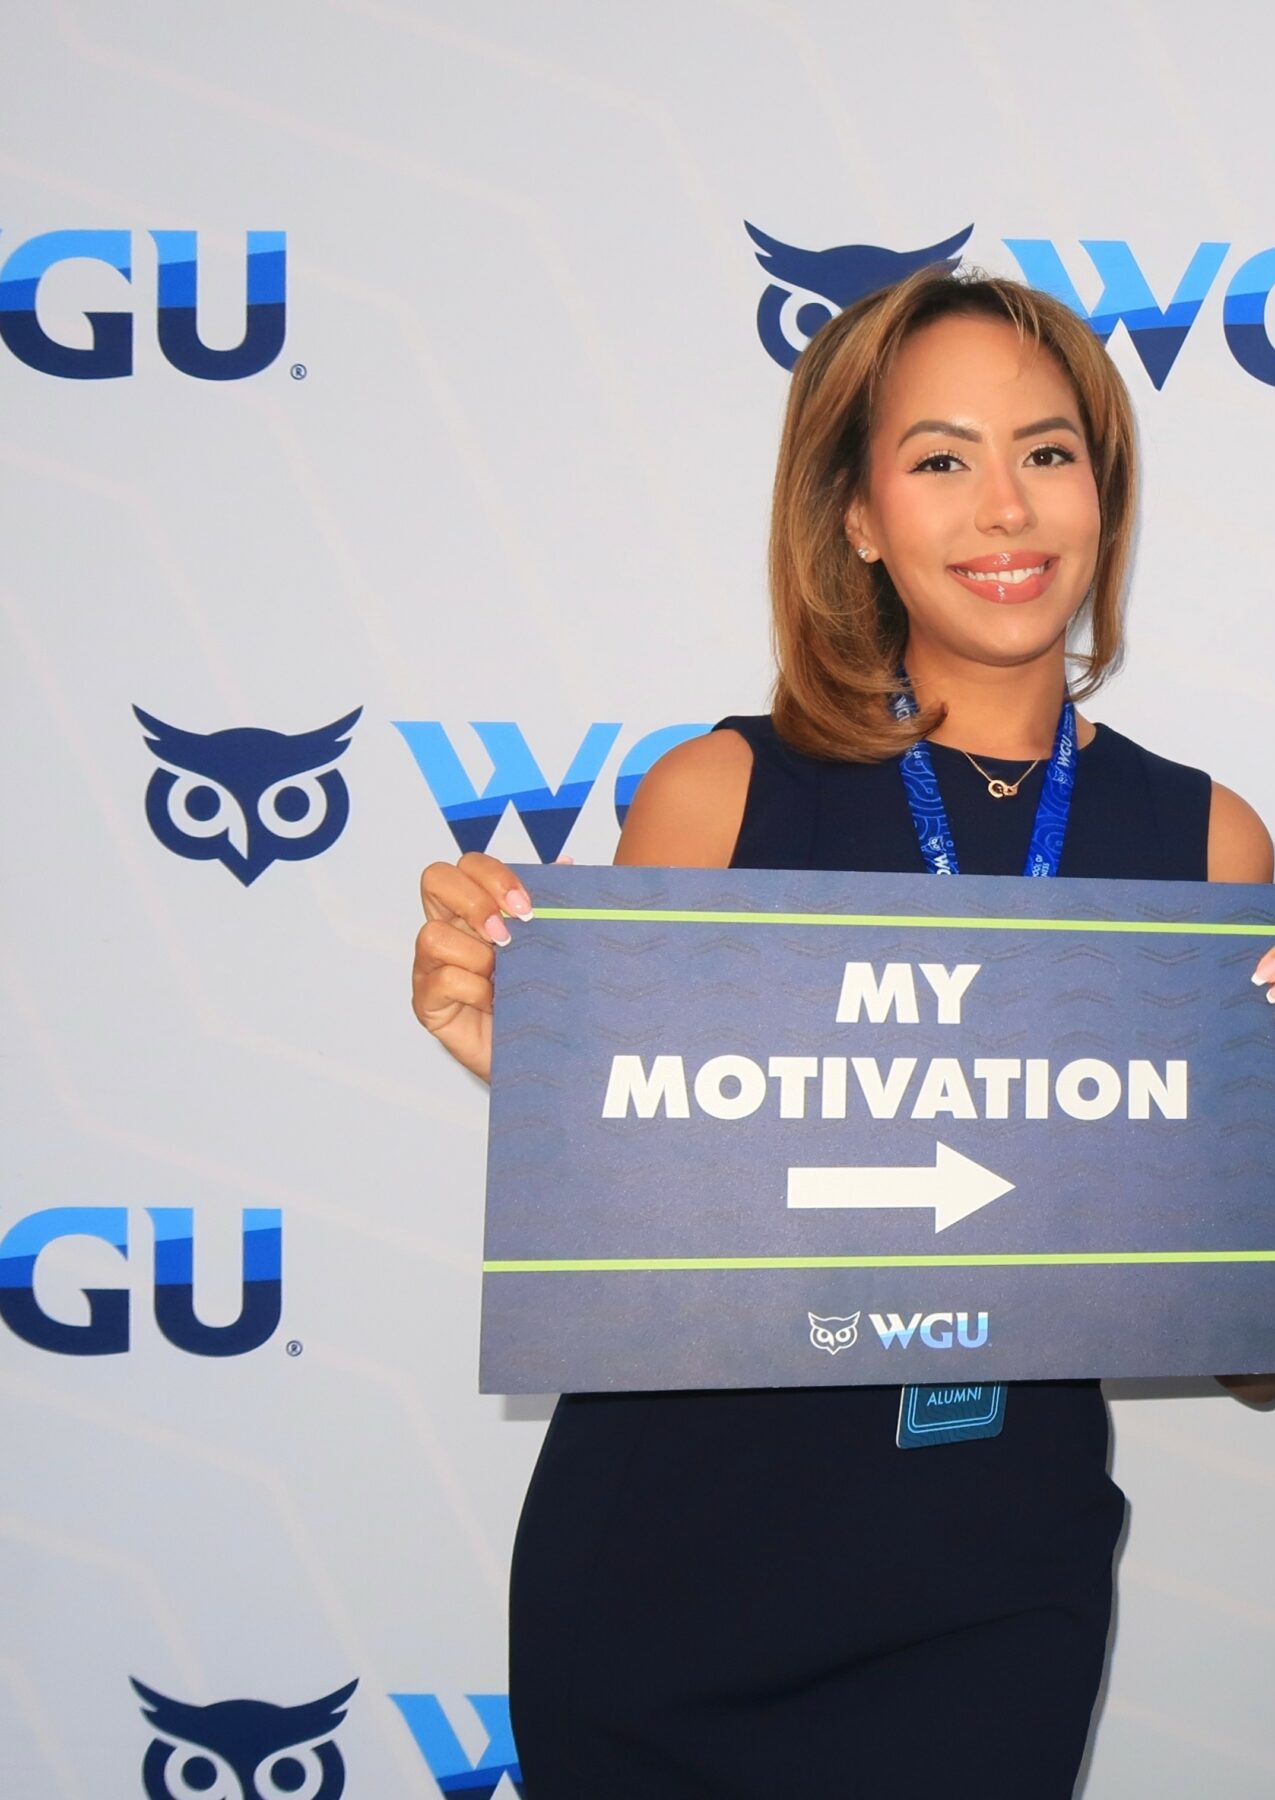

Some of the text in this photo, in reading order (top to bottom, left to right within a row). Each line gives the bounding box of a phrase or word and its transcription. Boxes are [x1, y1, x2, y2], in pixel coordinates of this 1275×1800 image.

[0, 229, 286, 381] GU
[1057, 733, 1073, 768] WGU
[835, 961, 981, 1024] MY
[601, 1055, 1187, 1120] MOTIVATION
[0, 1207, 282, 1357] GU
[869, 1312, 989, 1349] WGU
[927, 1387, 982, 1406] ALUMNI
